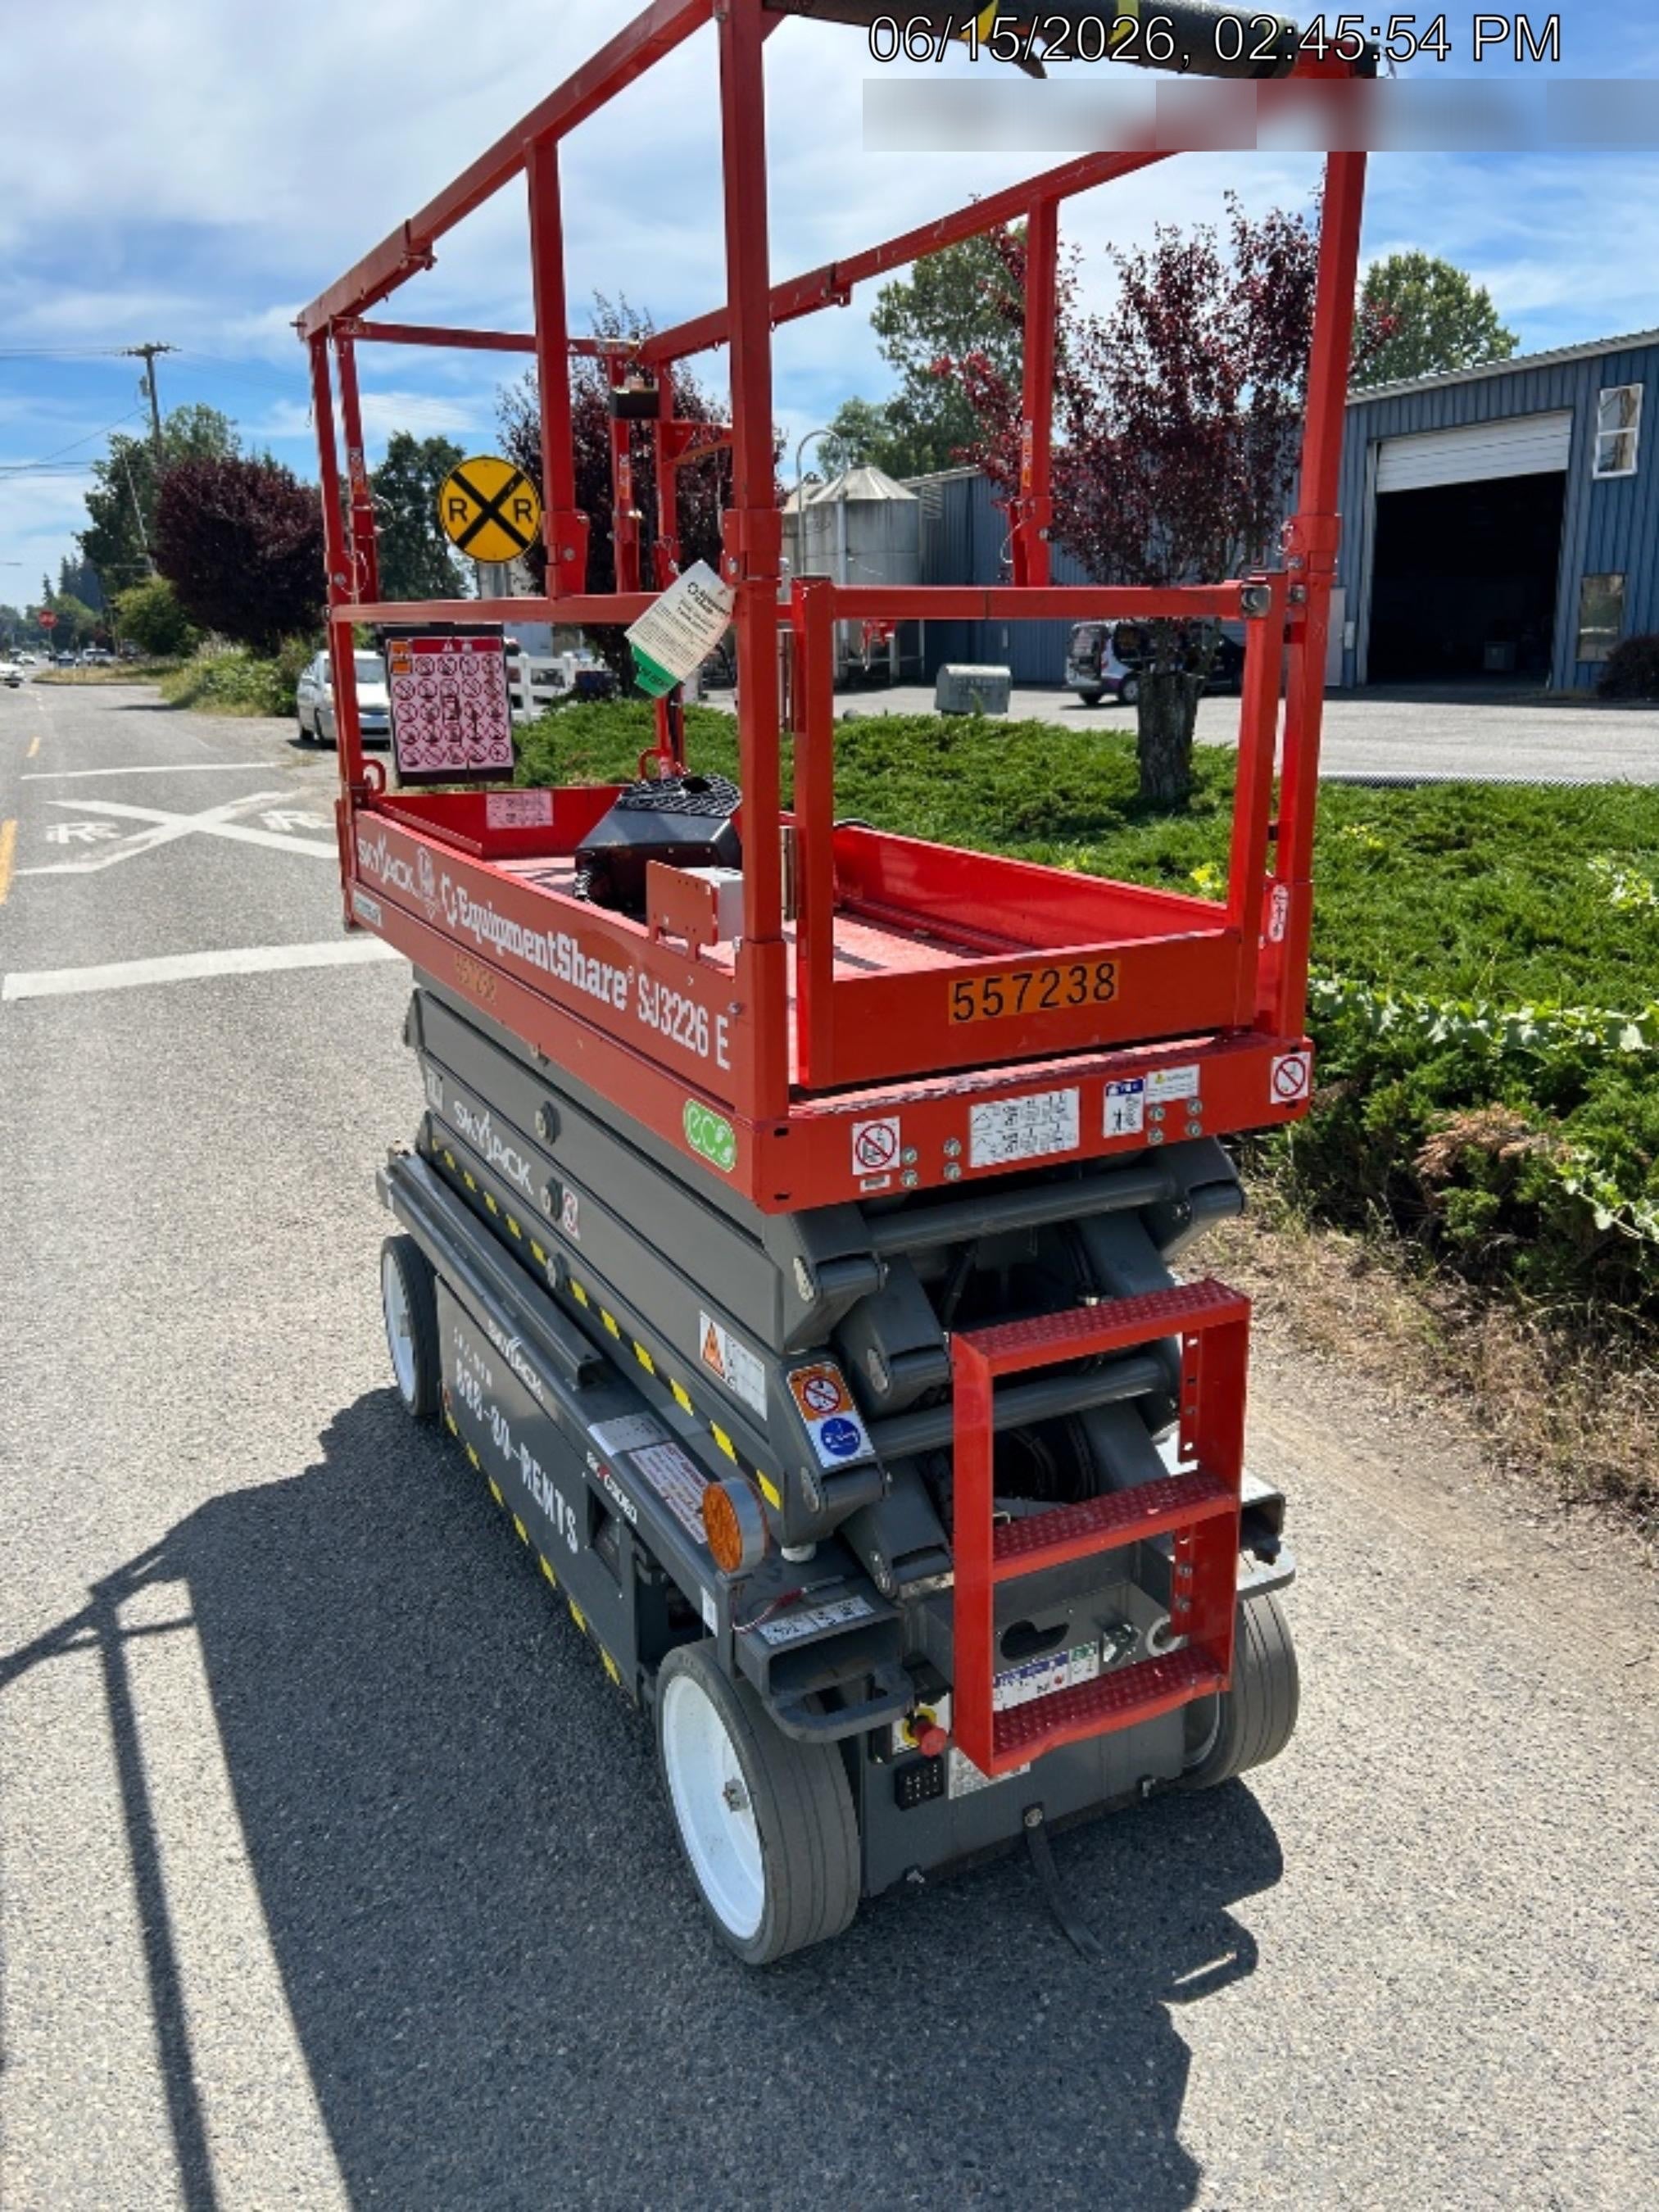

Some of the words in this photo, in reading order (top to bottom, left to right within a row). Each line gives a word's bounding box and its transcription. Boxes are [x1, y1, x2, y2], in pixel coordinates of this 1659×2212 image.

[449, 496, 468, 523] R
[514, 497, 533, 524] R
[357, 831, 420, 900] SKYJACK
[637, 972, 709, 1058] SJ3226
[716, 1013, 730, 1070] E
[954, 963, 1115, 1021] 557238
[454, 1100, 533, 1195] SKYJACK
